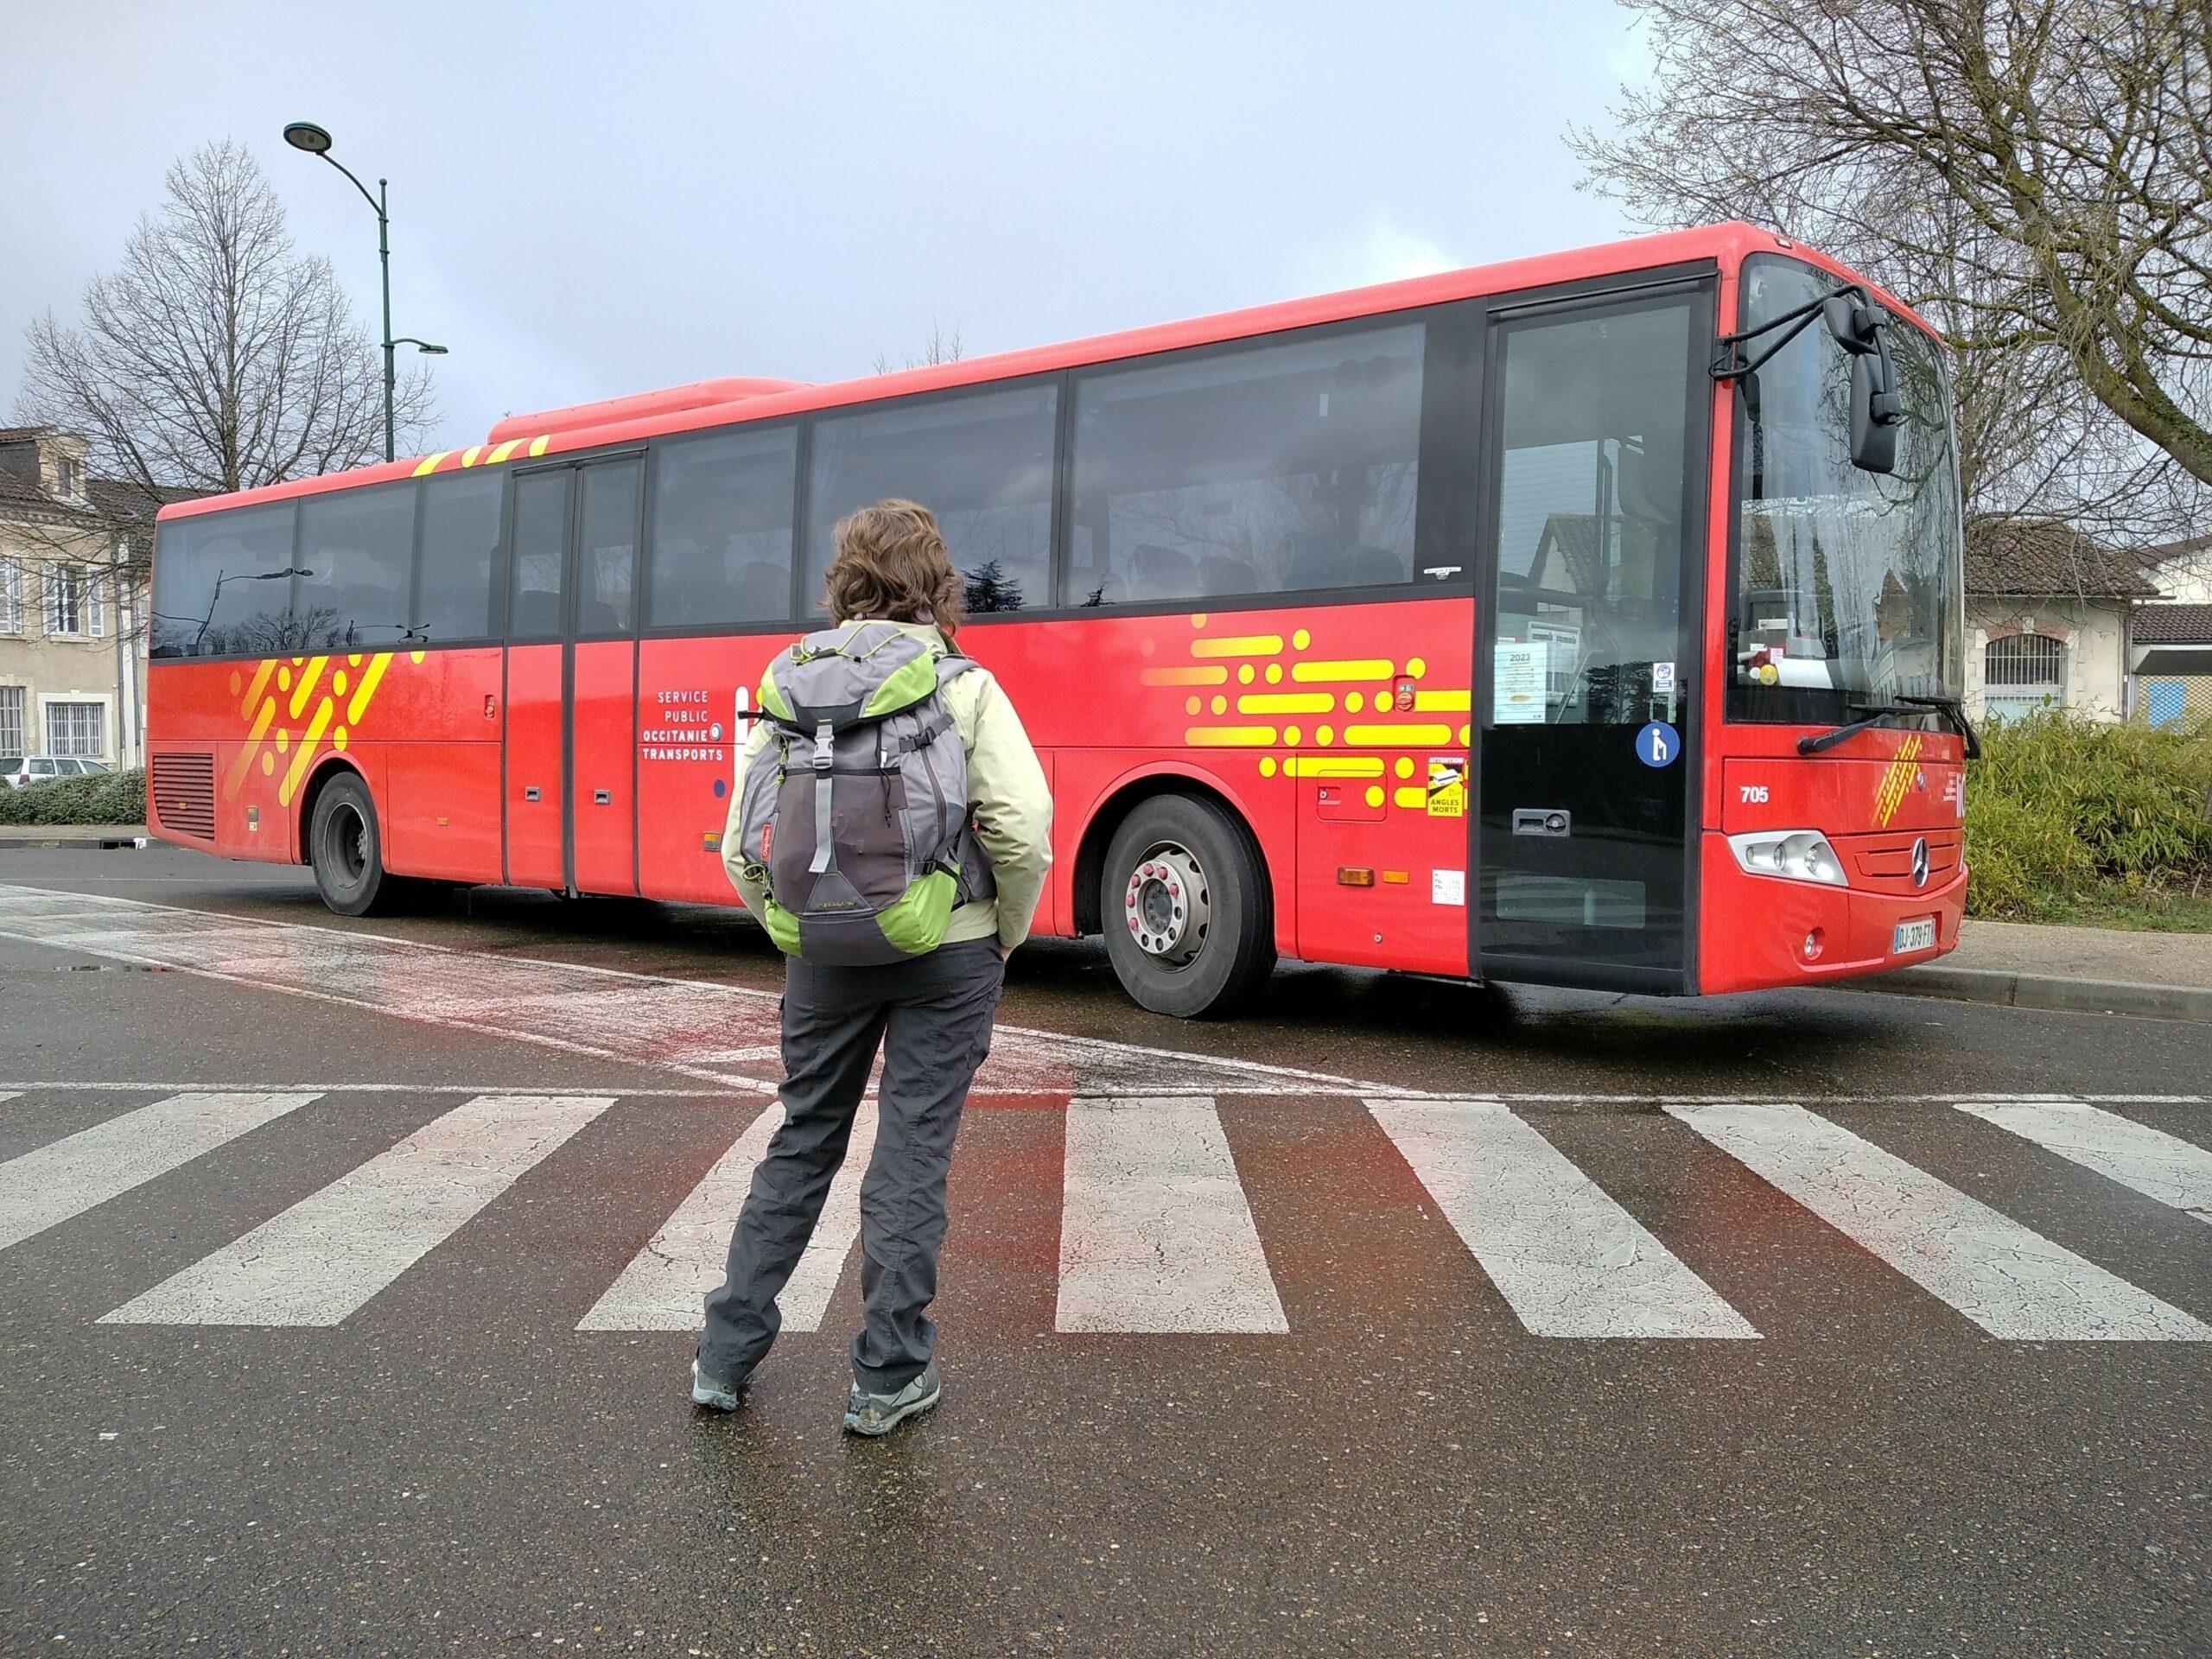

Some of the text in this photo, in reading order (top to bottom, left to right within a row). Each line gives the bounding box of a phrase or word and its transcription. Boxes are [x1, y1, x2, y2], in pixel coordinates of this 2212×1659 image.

[658, 691, 709, 703] SERVICE
[664, 710, 709, 722] PUBLIC
[643, 730, 709, 742] OCCITANIE
[643, 748, 723, 761] TRANSPORTS
[1740, 785, 1769, 803] 705
